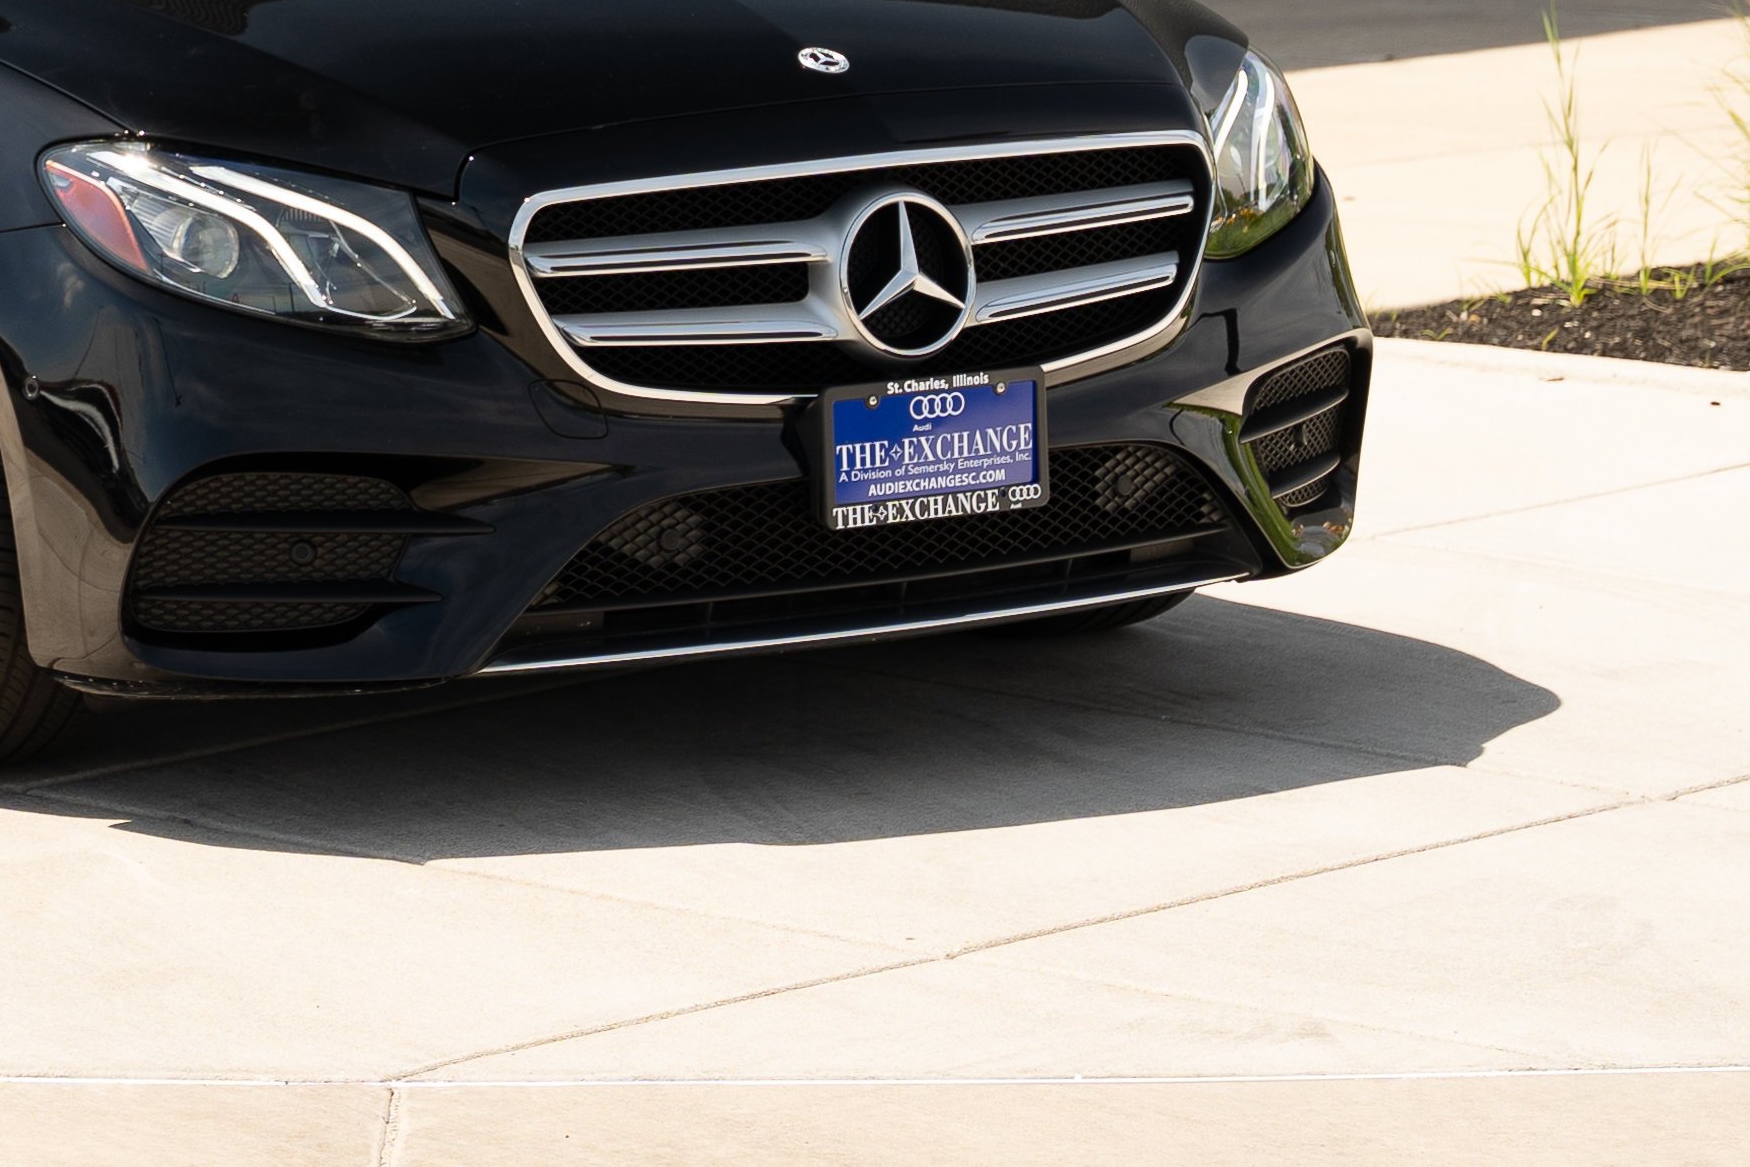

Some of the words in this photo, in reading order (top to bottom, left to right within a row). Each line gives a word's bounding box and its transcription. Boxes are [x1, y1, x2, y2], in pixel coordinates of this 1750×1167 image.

[887, 381, 903, 395] St.
[904, 377, 949, 393] Charles,
[952, 372, 990, 388] Illinois
[912, 422, 932, 433] Audi
[835, 440, 890, 471] THE
[902, 422, 1033, 465] EXCHANGE
[838, 472, 849, 483] A
[851, 468, 892, 482] Division
[894, 464, 906, 477] of
[907, 459, 955, 475] Semersky
[1015, 451, 1032, 462] Inc.
[868, 468, 1006, 497] AUDIEXCHANGESC.COM
[832, 503, 878, 530] THE
[886, 488, 1000, 524] EXCHANGE
